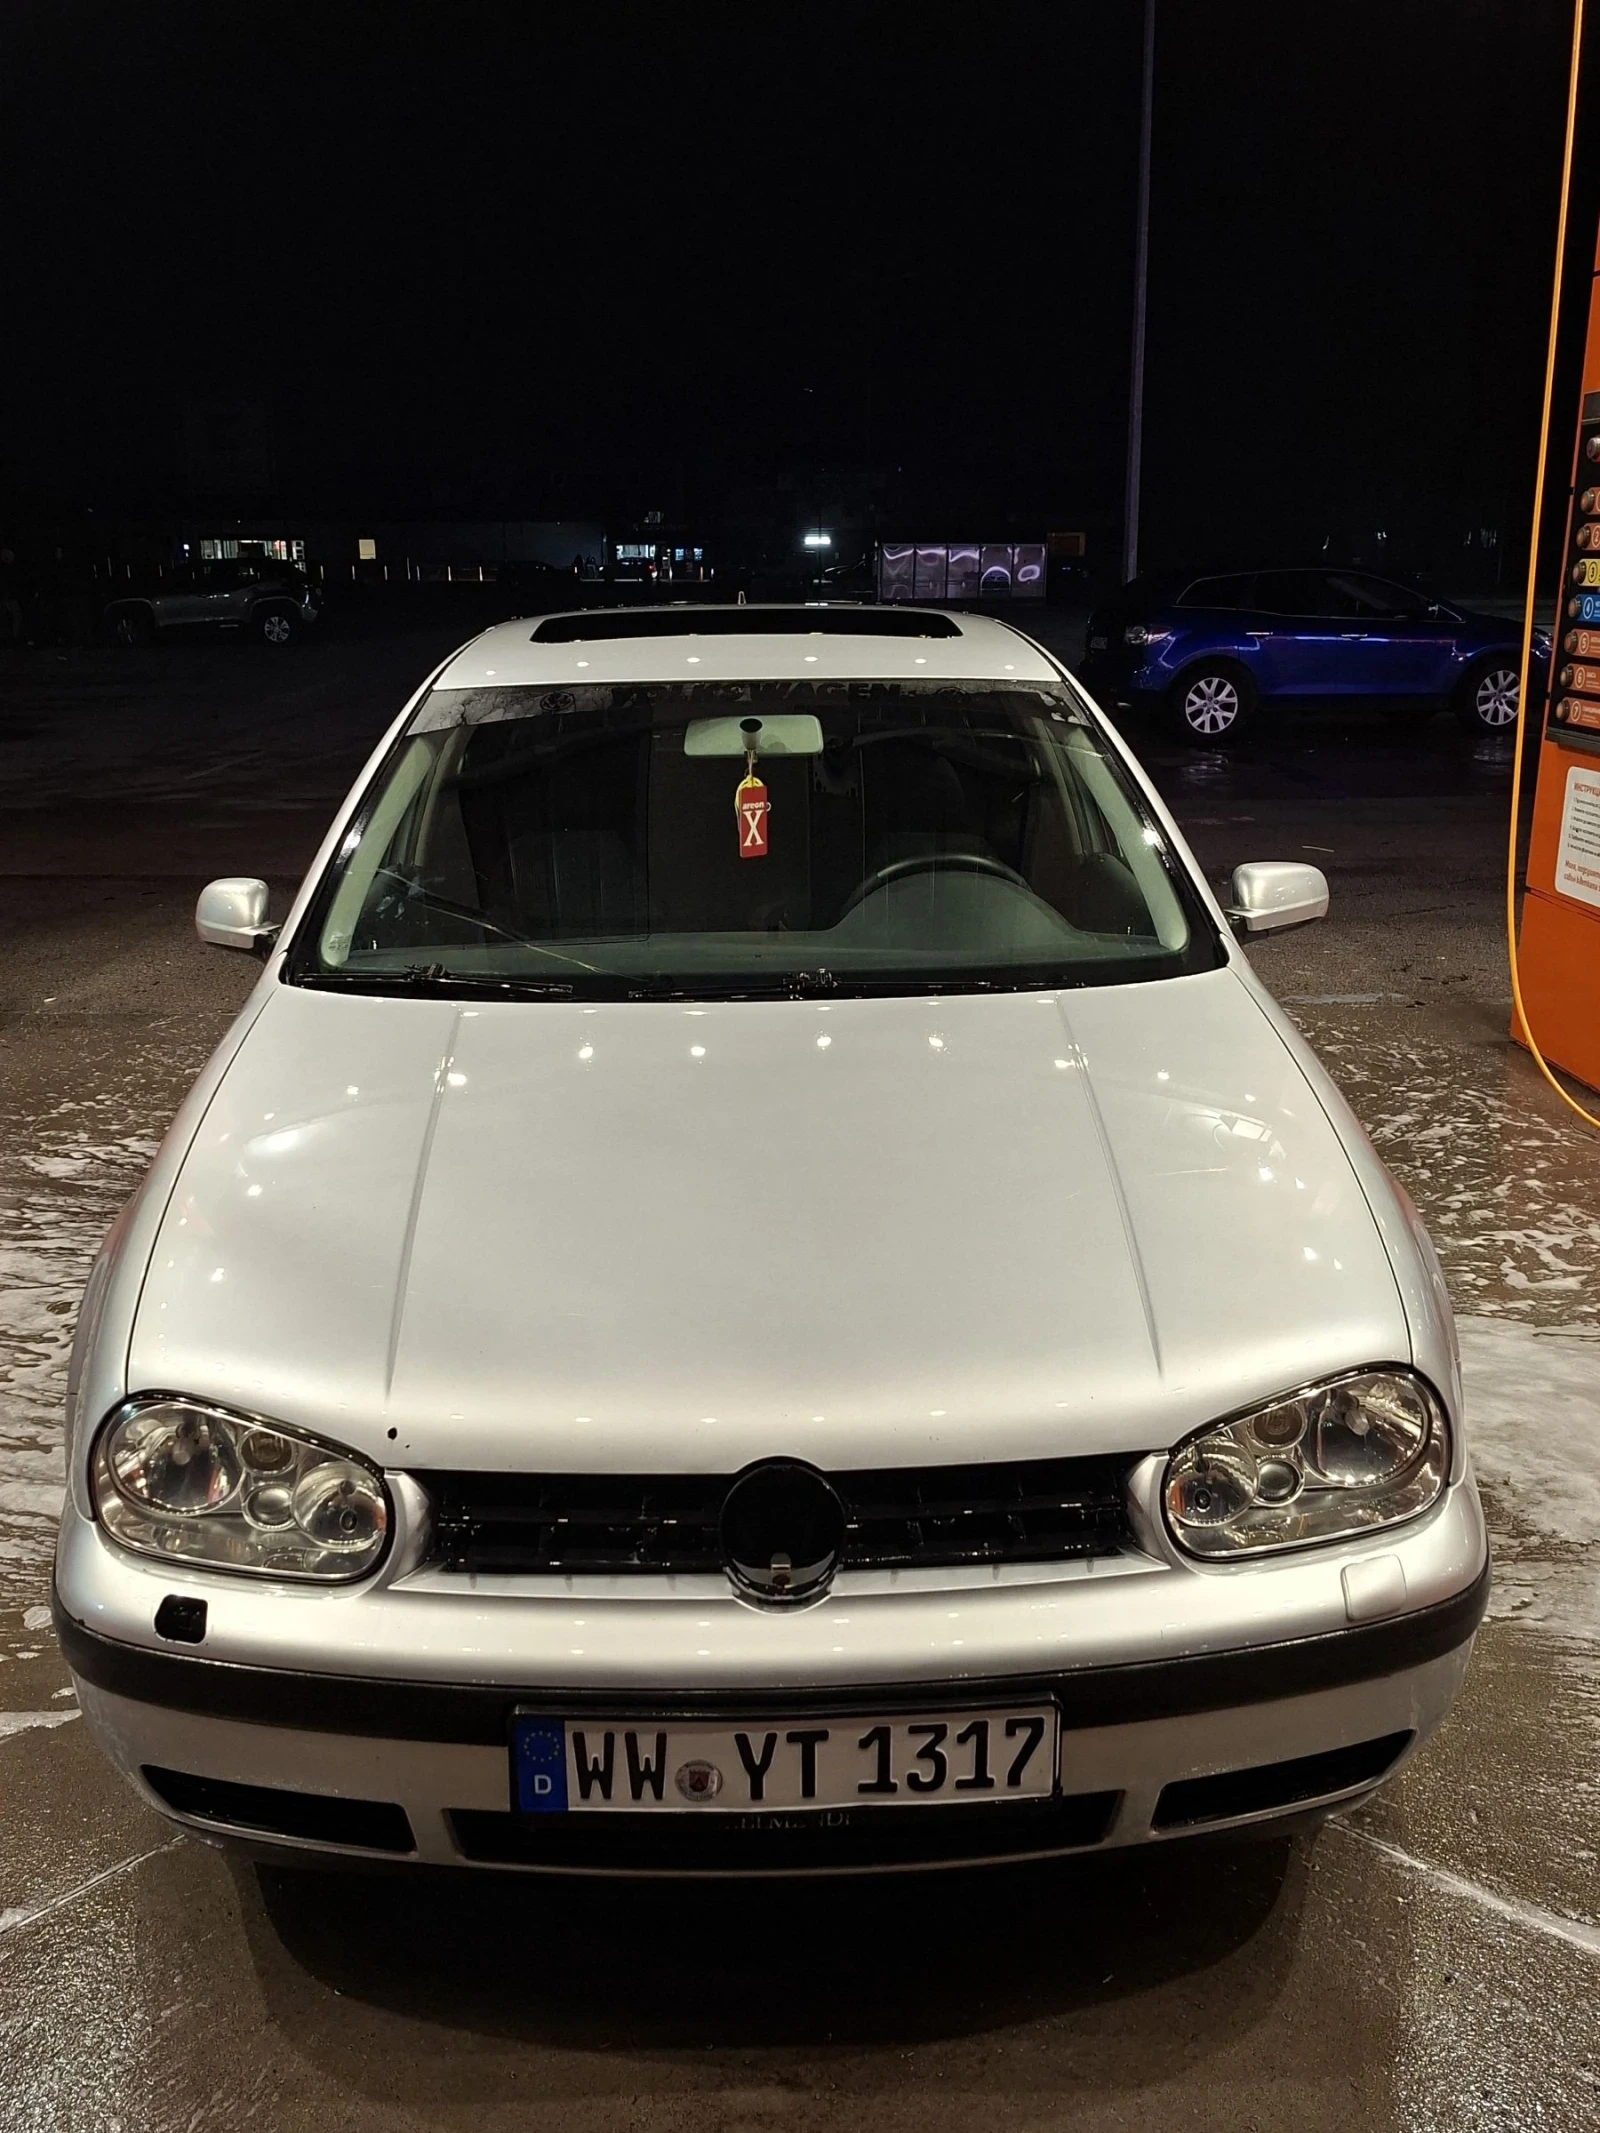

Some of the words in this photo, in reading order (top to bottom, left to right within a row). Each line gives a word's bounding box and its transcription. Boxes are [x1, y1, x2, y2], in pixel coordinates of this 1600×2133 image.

[742, 801, 766, 811] areon
[743, 810, 765, 847] X
[572, 1731, 668, 1801] WW
[734, 1729, 830, 1801] YT
[857, 1716, 1046, 1794] 1317
[533, 1774, 552, 1795] D
